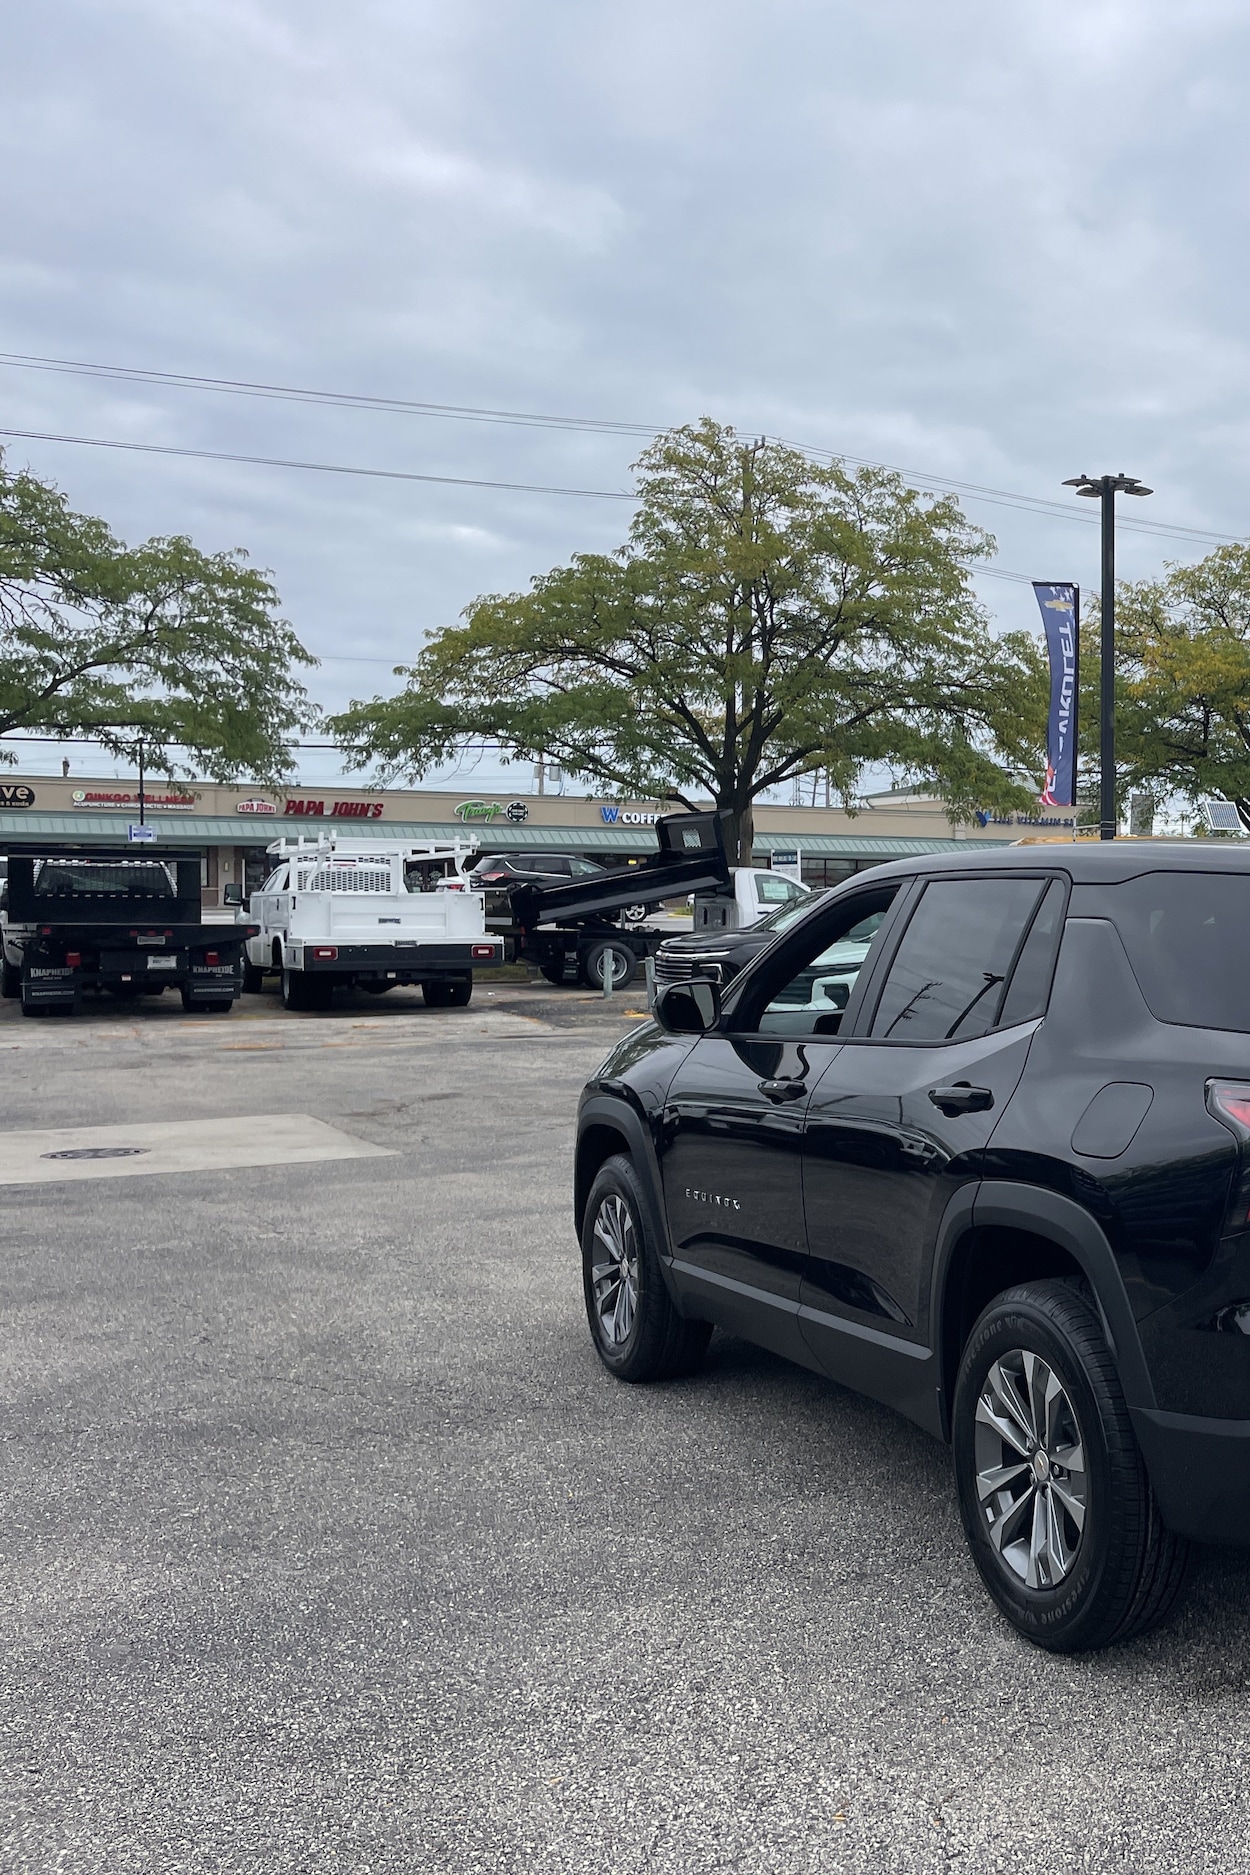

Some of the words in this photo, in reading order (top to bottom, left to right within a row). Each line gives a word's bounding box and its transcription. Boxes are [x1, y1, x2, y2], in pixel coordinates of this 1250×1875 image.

[0, 787, 29, 799] ve
[85, 792, 131, 802] GINKGO
[238, 803, 254, 811] PAPA
[284, 800, 325, 816] PAPA
[331, 802, 384, 818] JOHN'S
